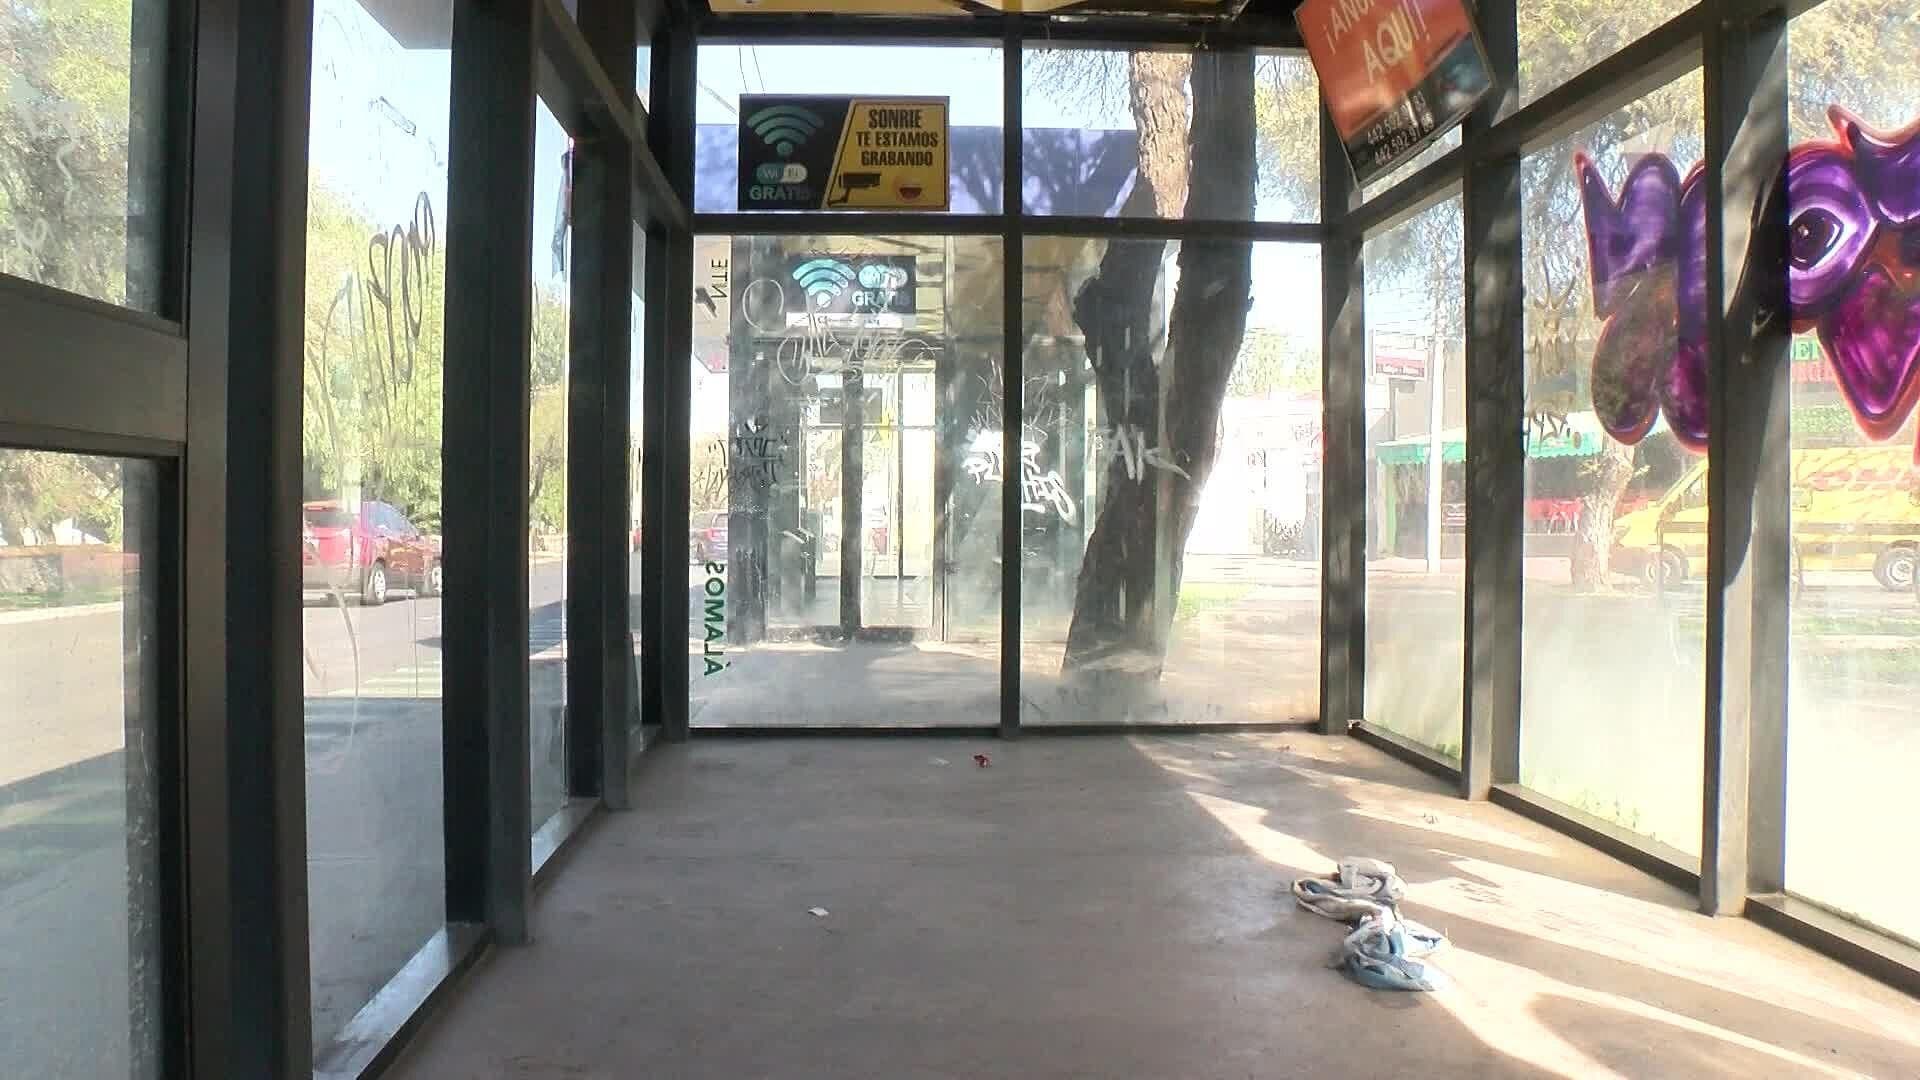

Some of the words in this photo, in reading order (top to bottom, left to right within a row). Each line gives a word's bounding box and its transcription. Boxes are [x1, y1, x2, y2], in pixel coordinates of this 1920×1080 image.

[868, 109, 922, 129] SONRIE
[856, 132, 871, 147] TE
[875, 132, 938, 148] ESTAMOS
[861, 151, 933, 166] GRABANDO
